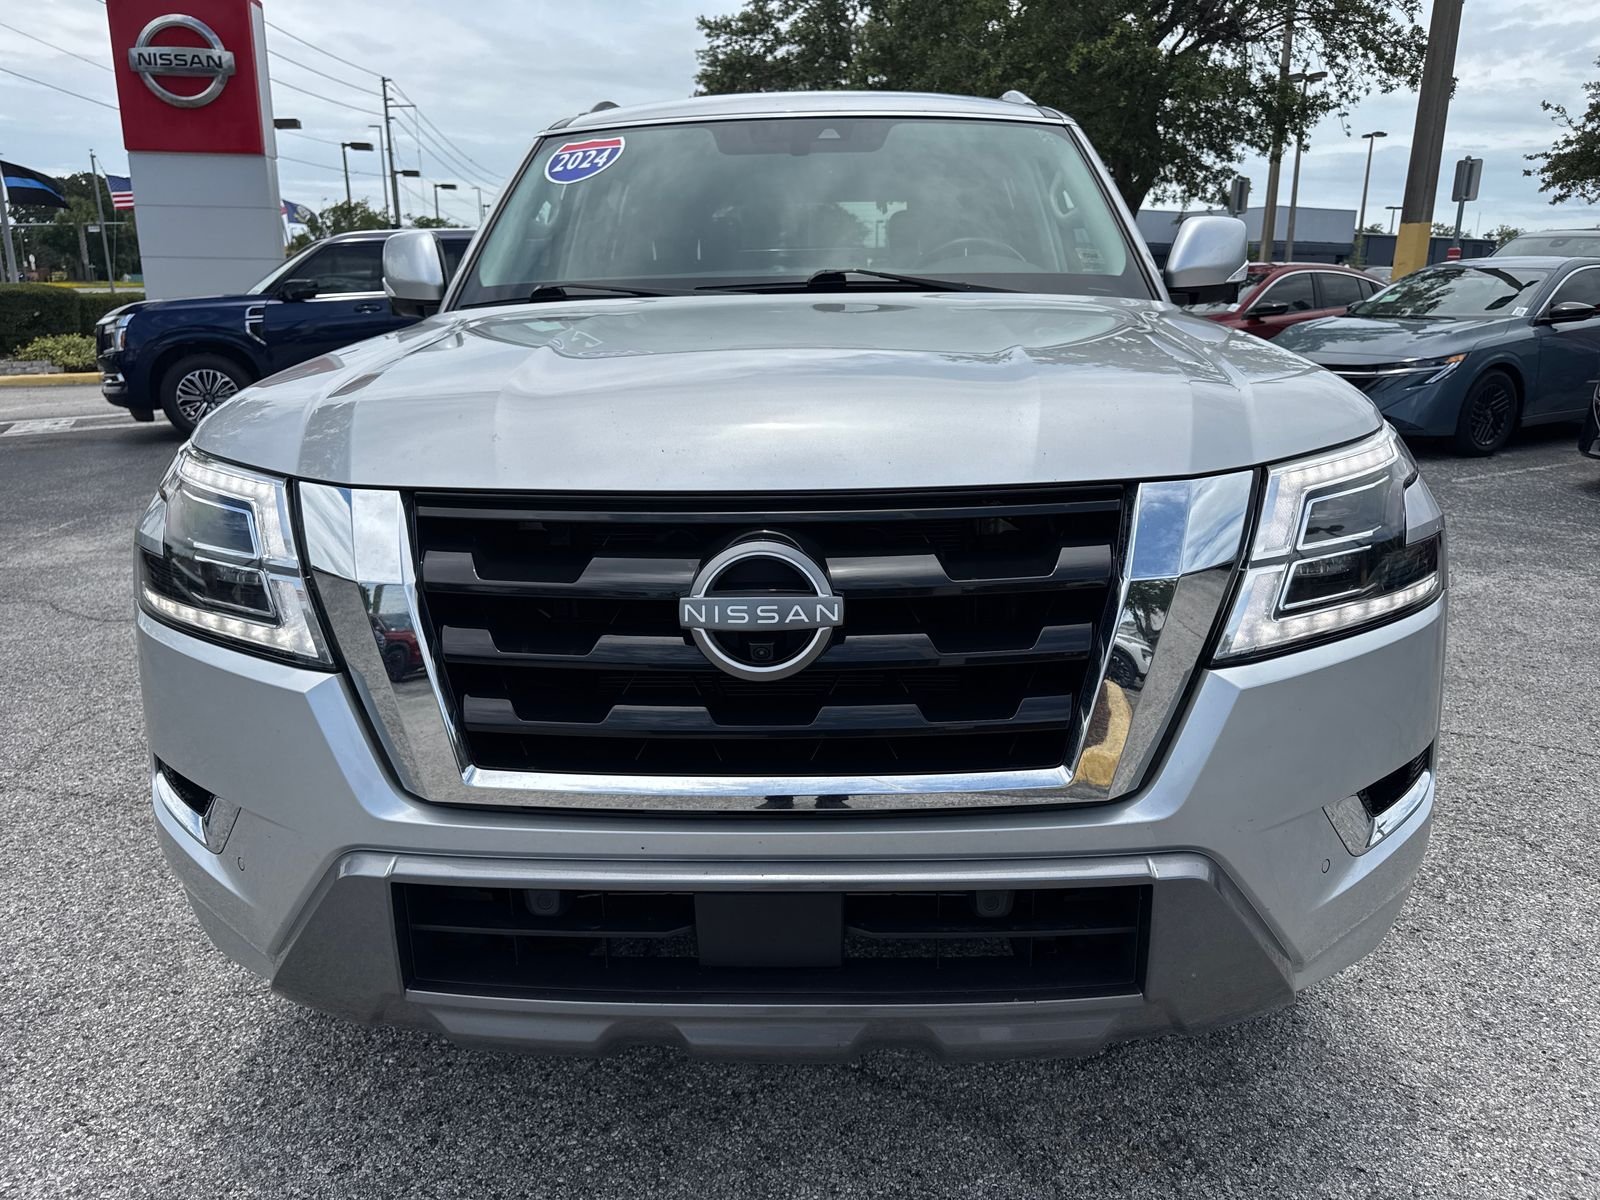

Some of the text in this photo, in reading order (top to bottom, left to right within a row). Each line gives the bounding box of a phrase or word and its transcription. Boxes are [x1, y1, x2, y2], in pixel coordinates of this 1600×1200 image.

[137, 52, 223, 69] NISSAN
[551, 148, 612, 173] 2024
[684, 603, 839, 624] NISSAN
